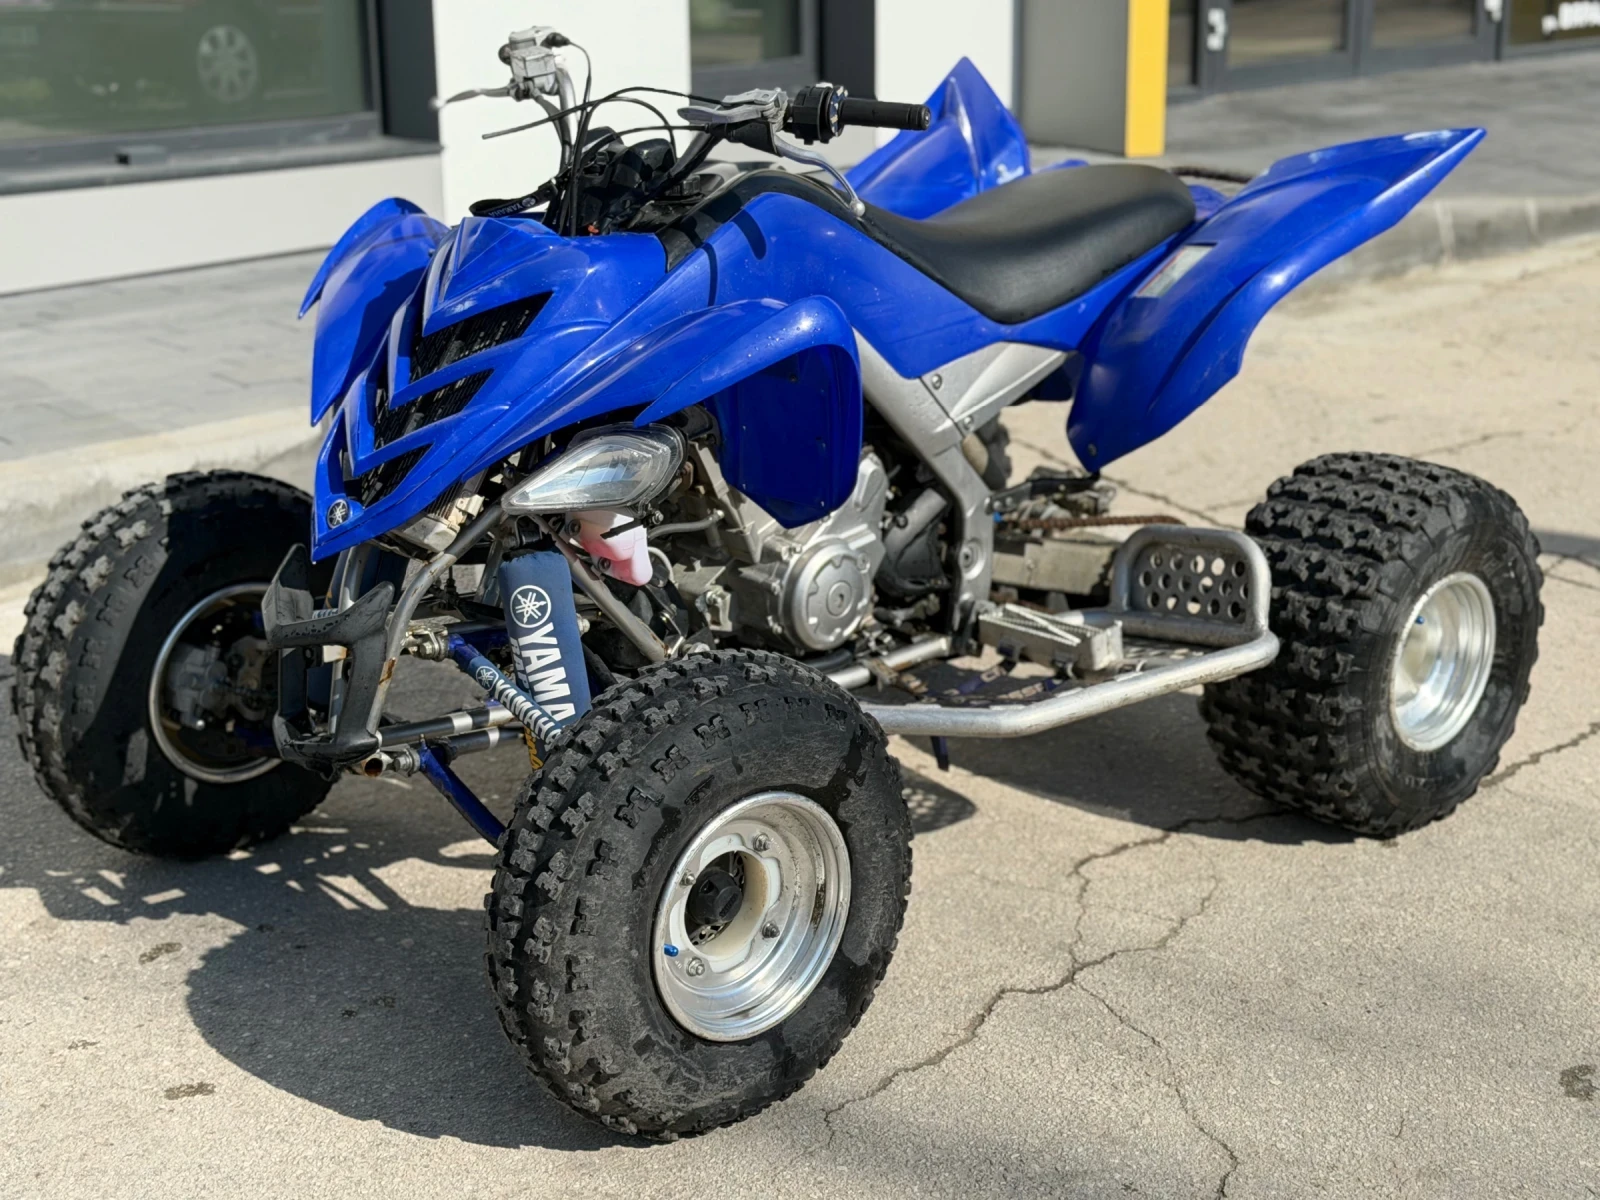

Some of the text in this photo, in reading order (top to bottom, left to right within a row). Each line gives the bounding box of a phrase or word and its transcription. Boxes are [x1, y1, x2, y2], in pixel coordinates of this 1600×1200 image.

[488, 203, 523, 217] YAMAHA
[510, 637, 530, 690] RAP
[518, 622, 576, 723] YAMA
